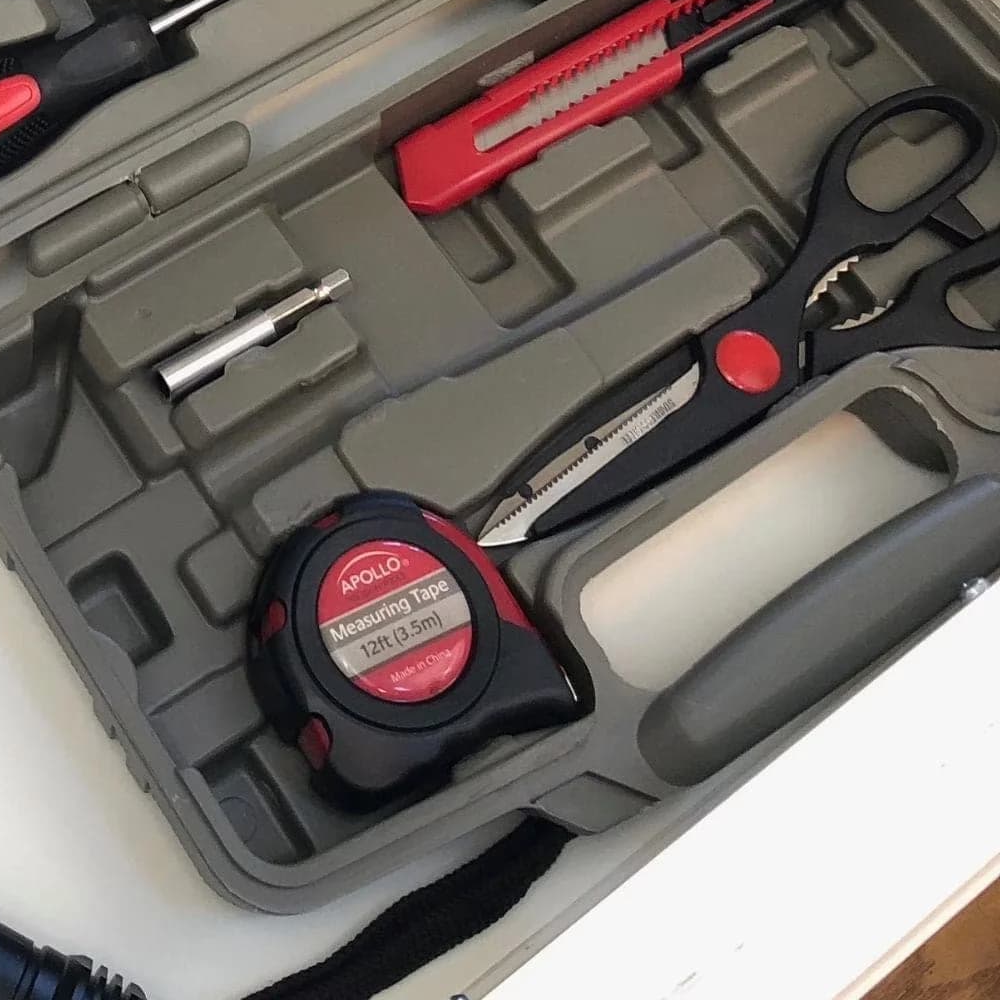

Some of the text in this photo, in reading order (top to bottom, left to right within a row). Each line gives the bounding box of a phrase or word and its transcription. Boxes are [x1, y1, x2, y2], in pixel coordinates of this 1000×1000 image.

[341, 557, 401, 595] APOLLO
[330, 580, 449, 642] Measuring Tape
[360, 610, 443, 658] 12ft (3.5m)
[390, 649, 451, 683] Made in China
